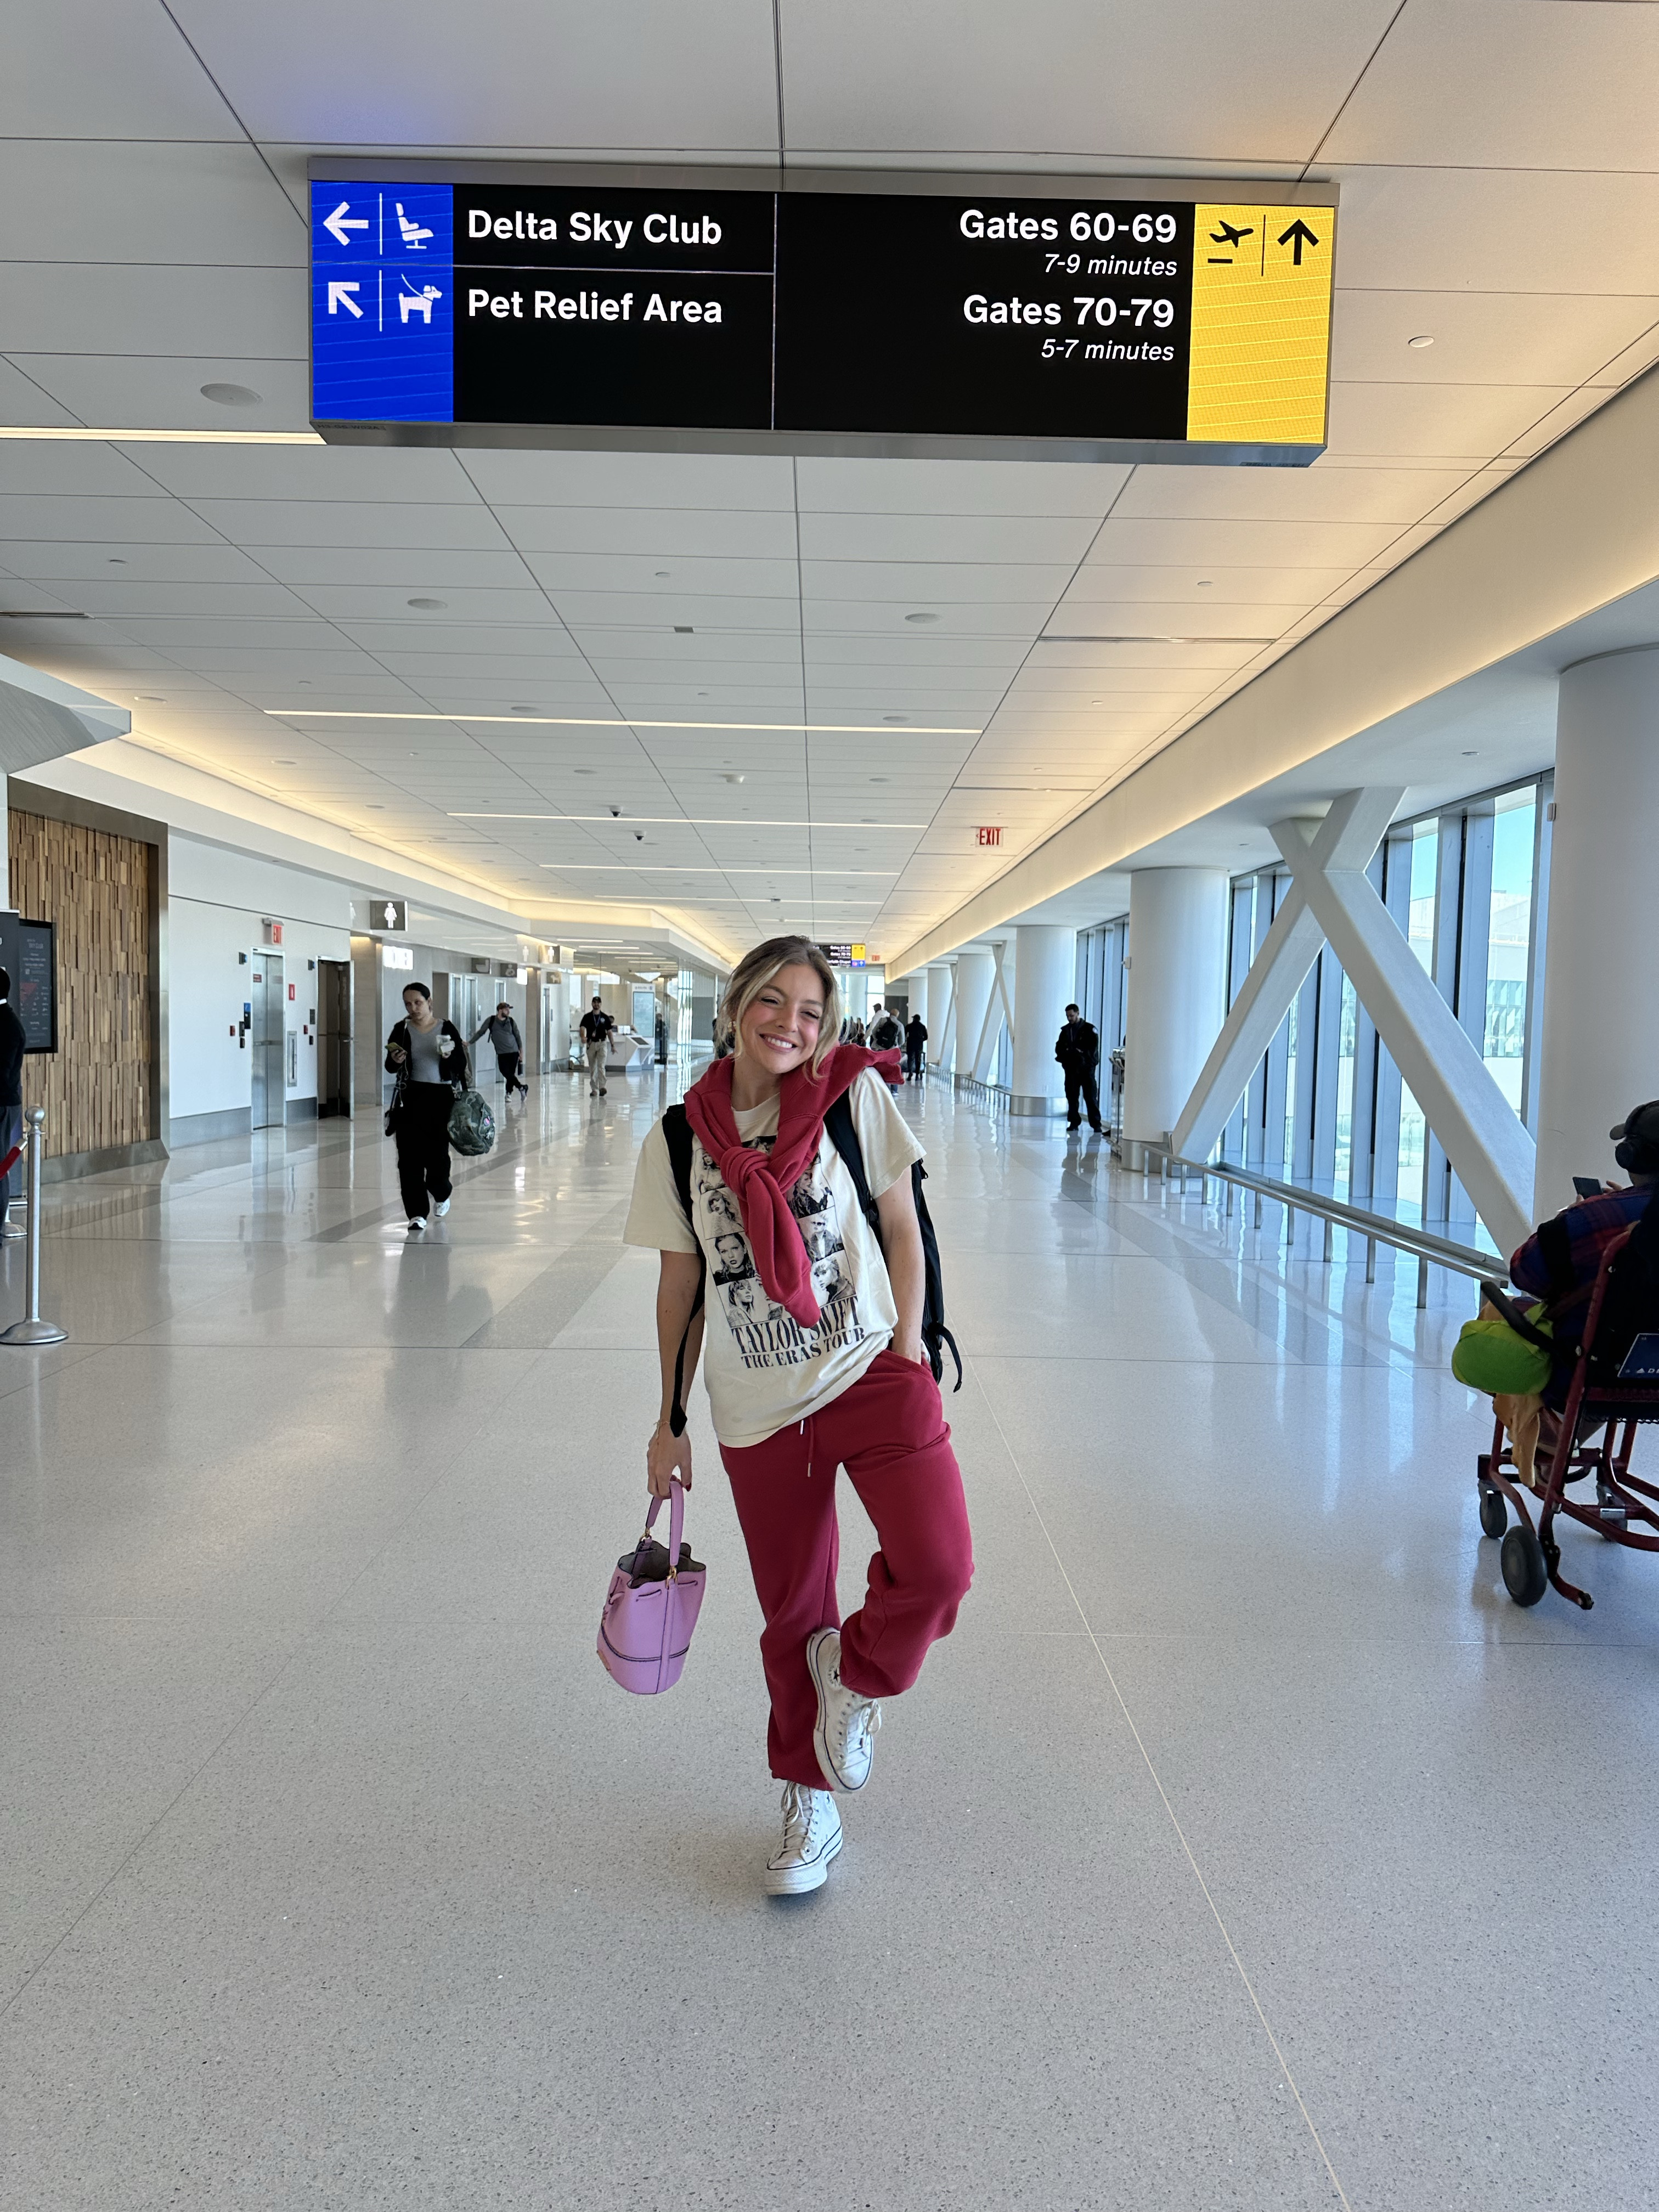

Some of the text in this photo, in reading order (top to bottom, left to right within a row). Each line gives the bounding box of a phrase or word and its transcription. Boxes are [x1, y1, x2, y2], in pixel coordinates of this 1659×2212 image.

[469, 210, 722, 249] Delta Sky Club
[960, 209, 1177, 244] Gates 60-69
[1045, 253, 1178, 276] 7-9 minutes
[469, 289, 722, 324] Pet Relief Area
[963, 294, 1175, 328] Gates 70-79
[1041, 338, 1175, 362] 5-7 minutes
[979, 827, 1001, 845] EXIT
[731, 1317, 806, 1354] TAYLOR
[741, 1327, 865, 1369] THE ERAS TOUR
